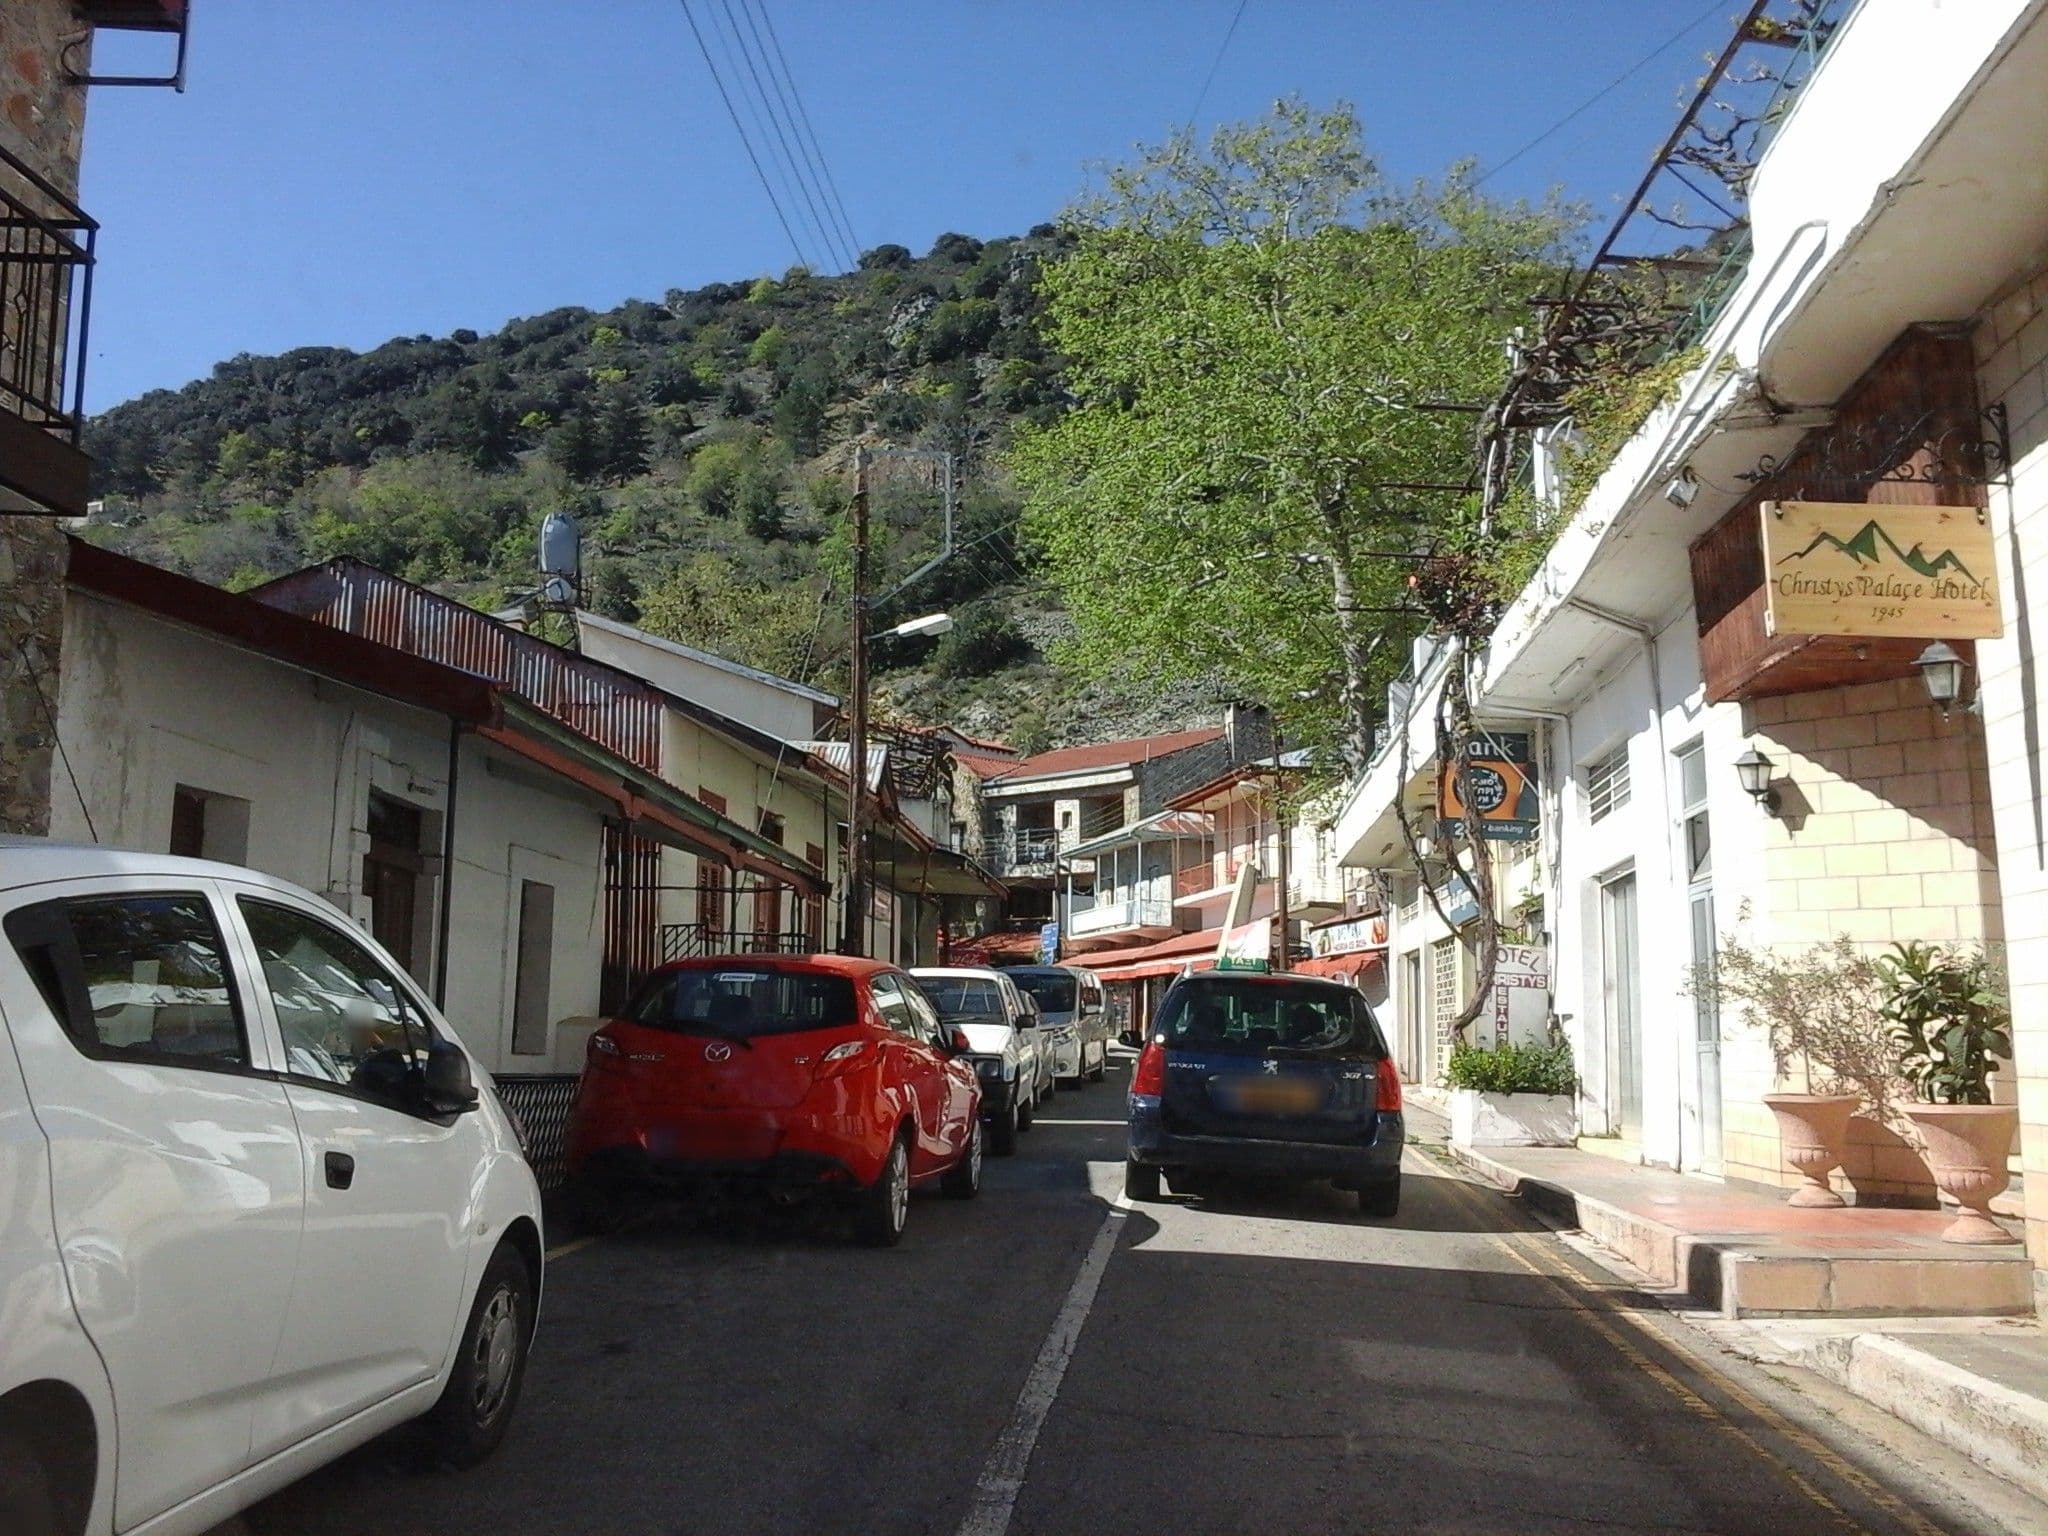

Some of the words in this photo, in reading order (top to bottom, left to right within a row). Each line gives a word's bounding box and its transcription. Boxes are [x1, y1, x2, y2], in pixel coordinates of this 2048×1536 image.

[1779, 571, 1854, 604] Christys
[1857, 574, 1922, 602] Palace
[1929, 576, 1993, 601] Hotel
[1871, 607, 1904, 622] 1945
[1468, 735, 1514, 757] ank
[1496, 947, 1540, 973] OTEL
[1496, 973, 1546, 989] RISTYS
